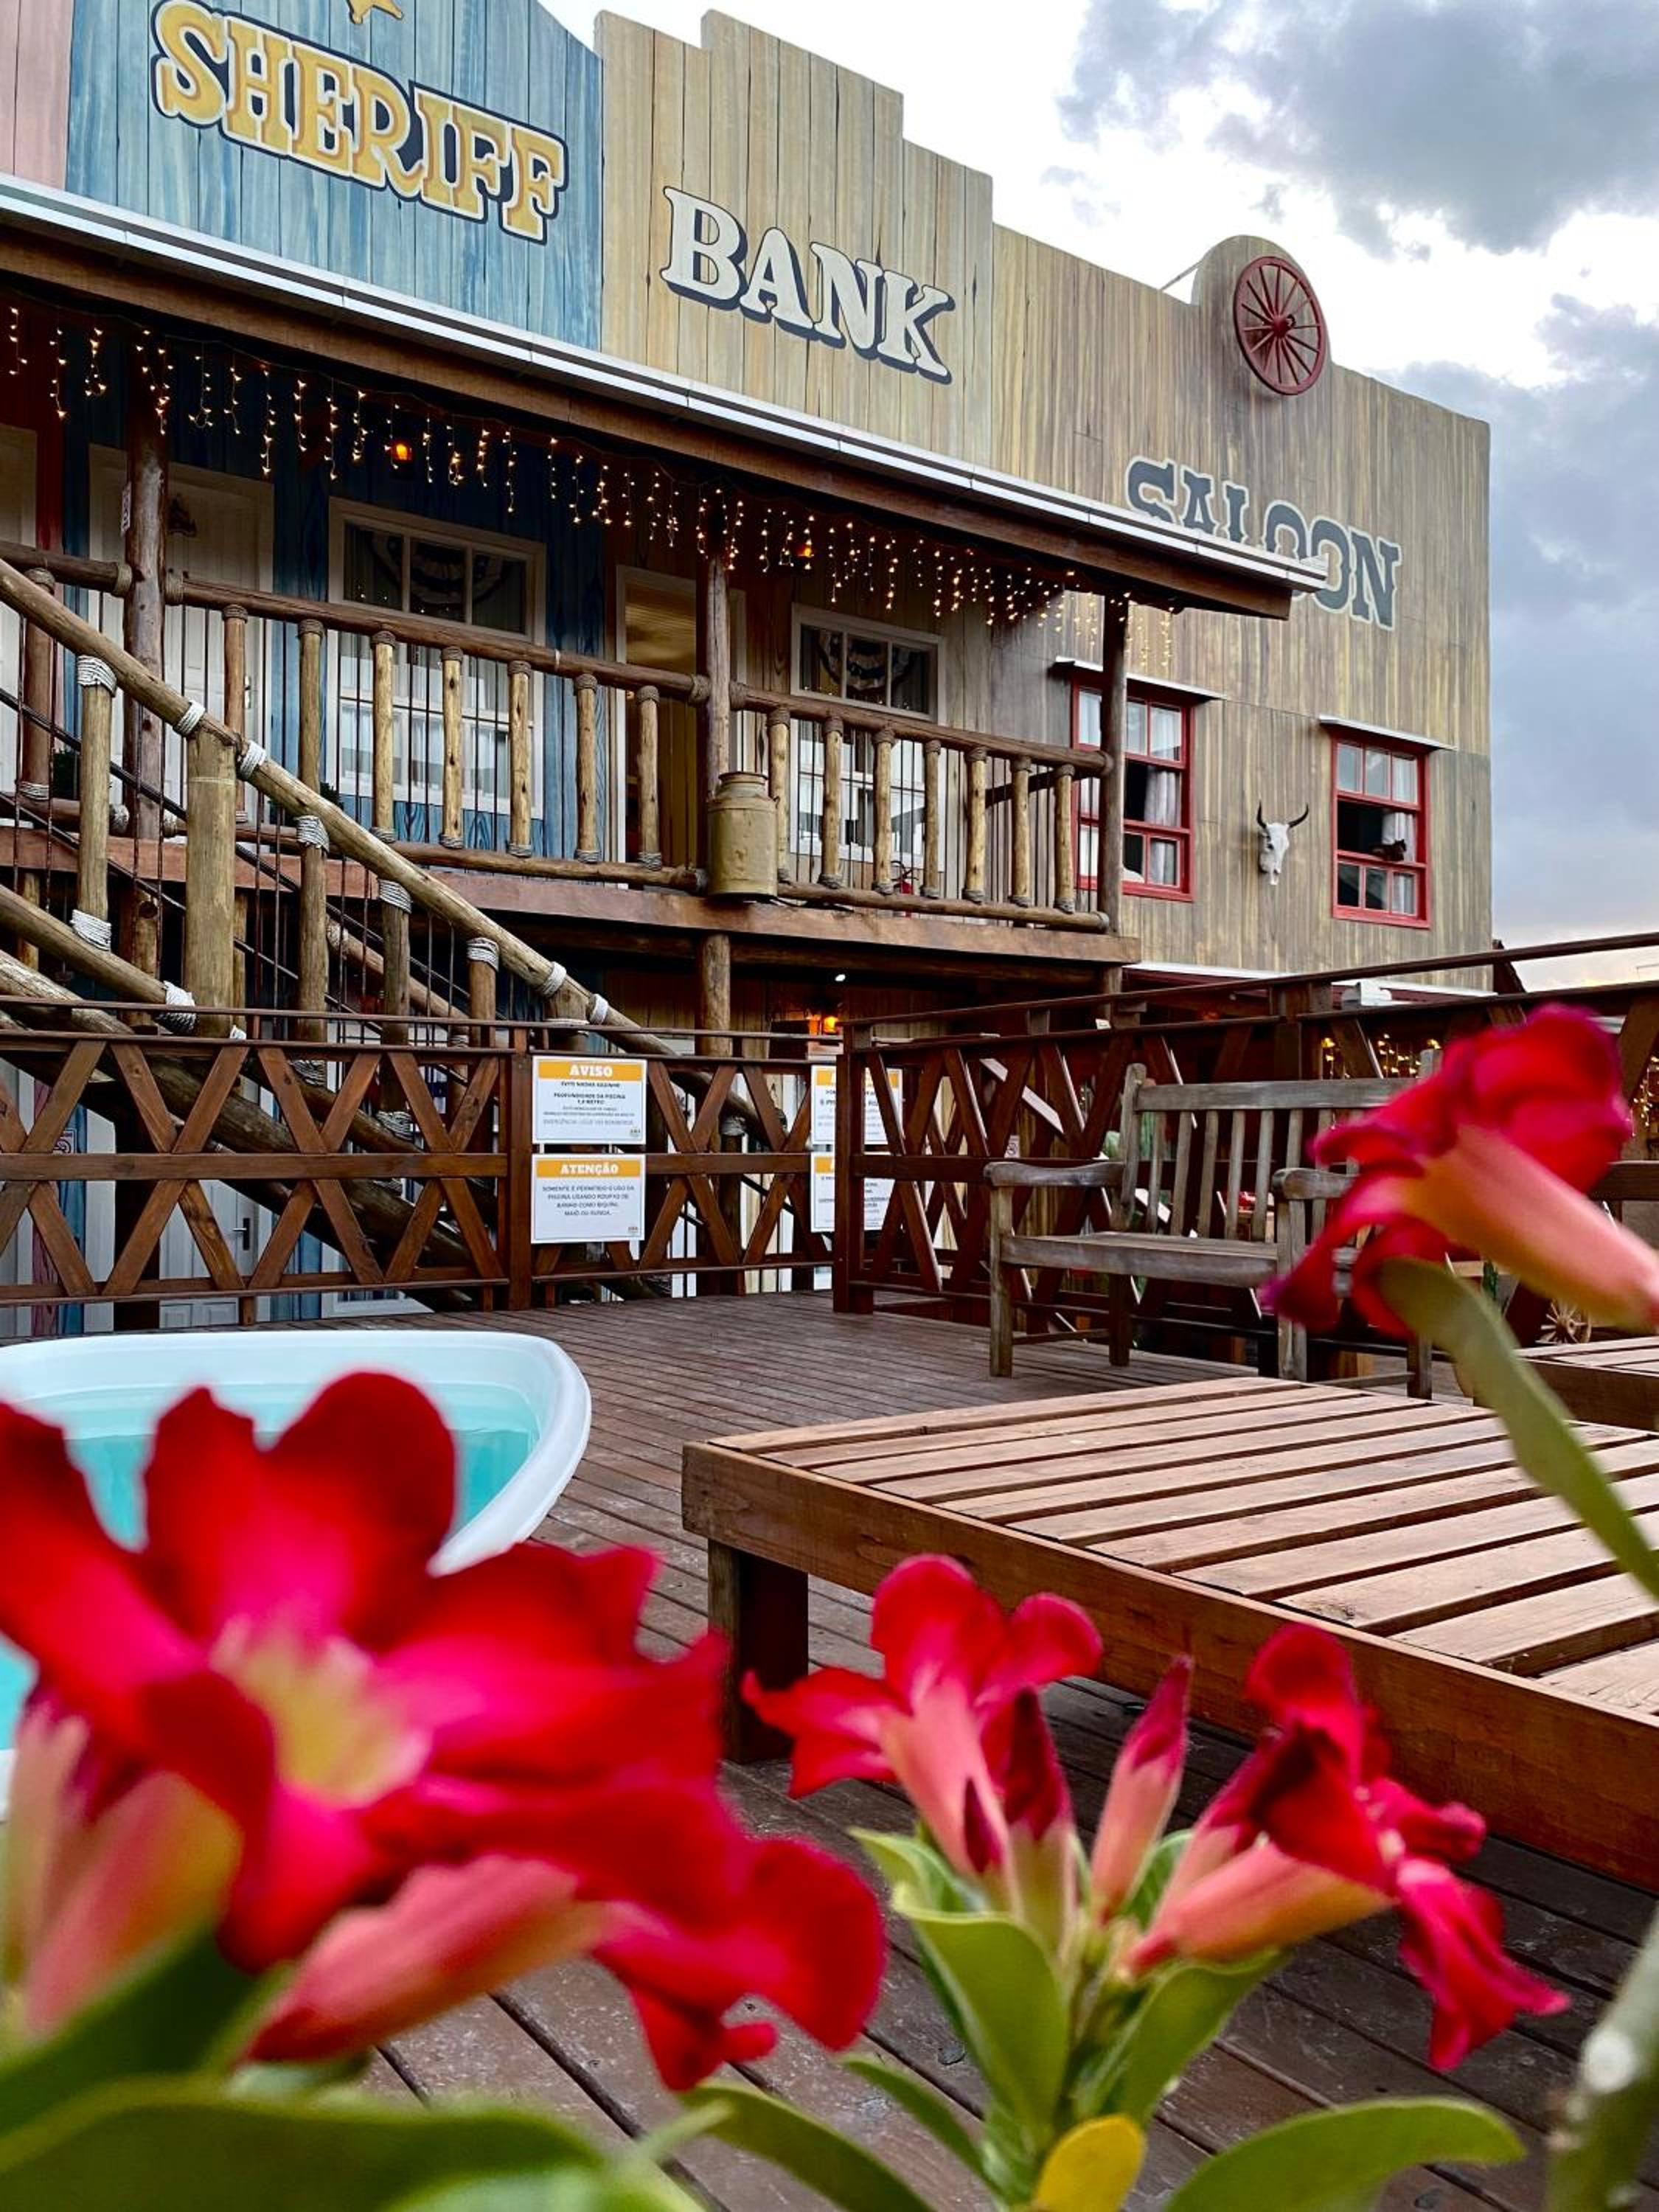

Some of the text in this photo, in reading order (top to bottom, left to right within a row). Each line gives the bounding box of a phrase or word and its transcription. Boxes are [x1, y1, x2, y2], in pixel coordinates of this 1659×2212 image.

[151, 4, 567, 244] SHERIFF
[661, 187, 955, 385] BANK
[1125, 456, 1401, 631] SALOON
[569, 1065, 613, 1077] AVISO
[560, 1161, 619, 1175] ATENÇÃO
